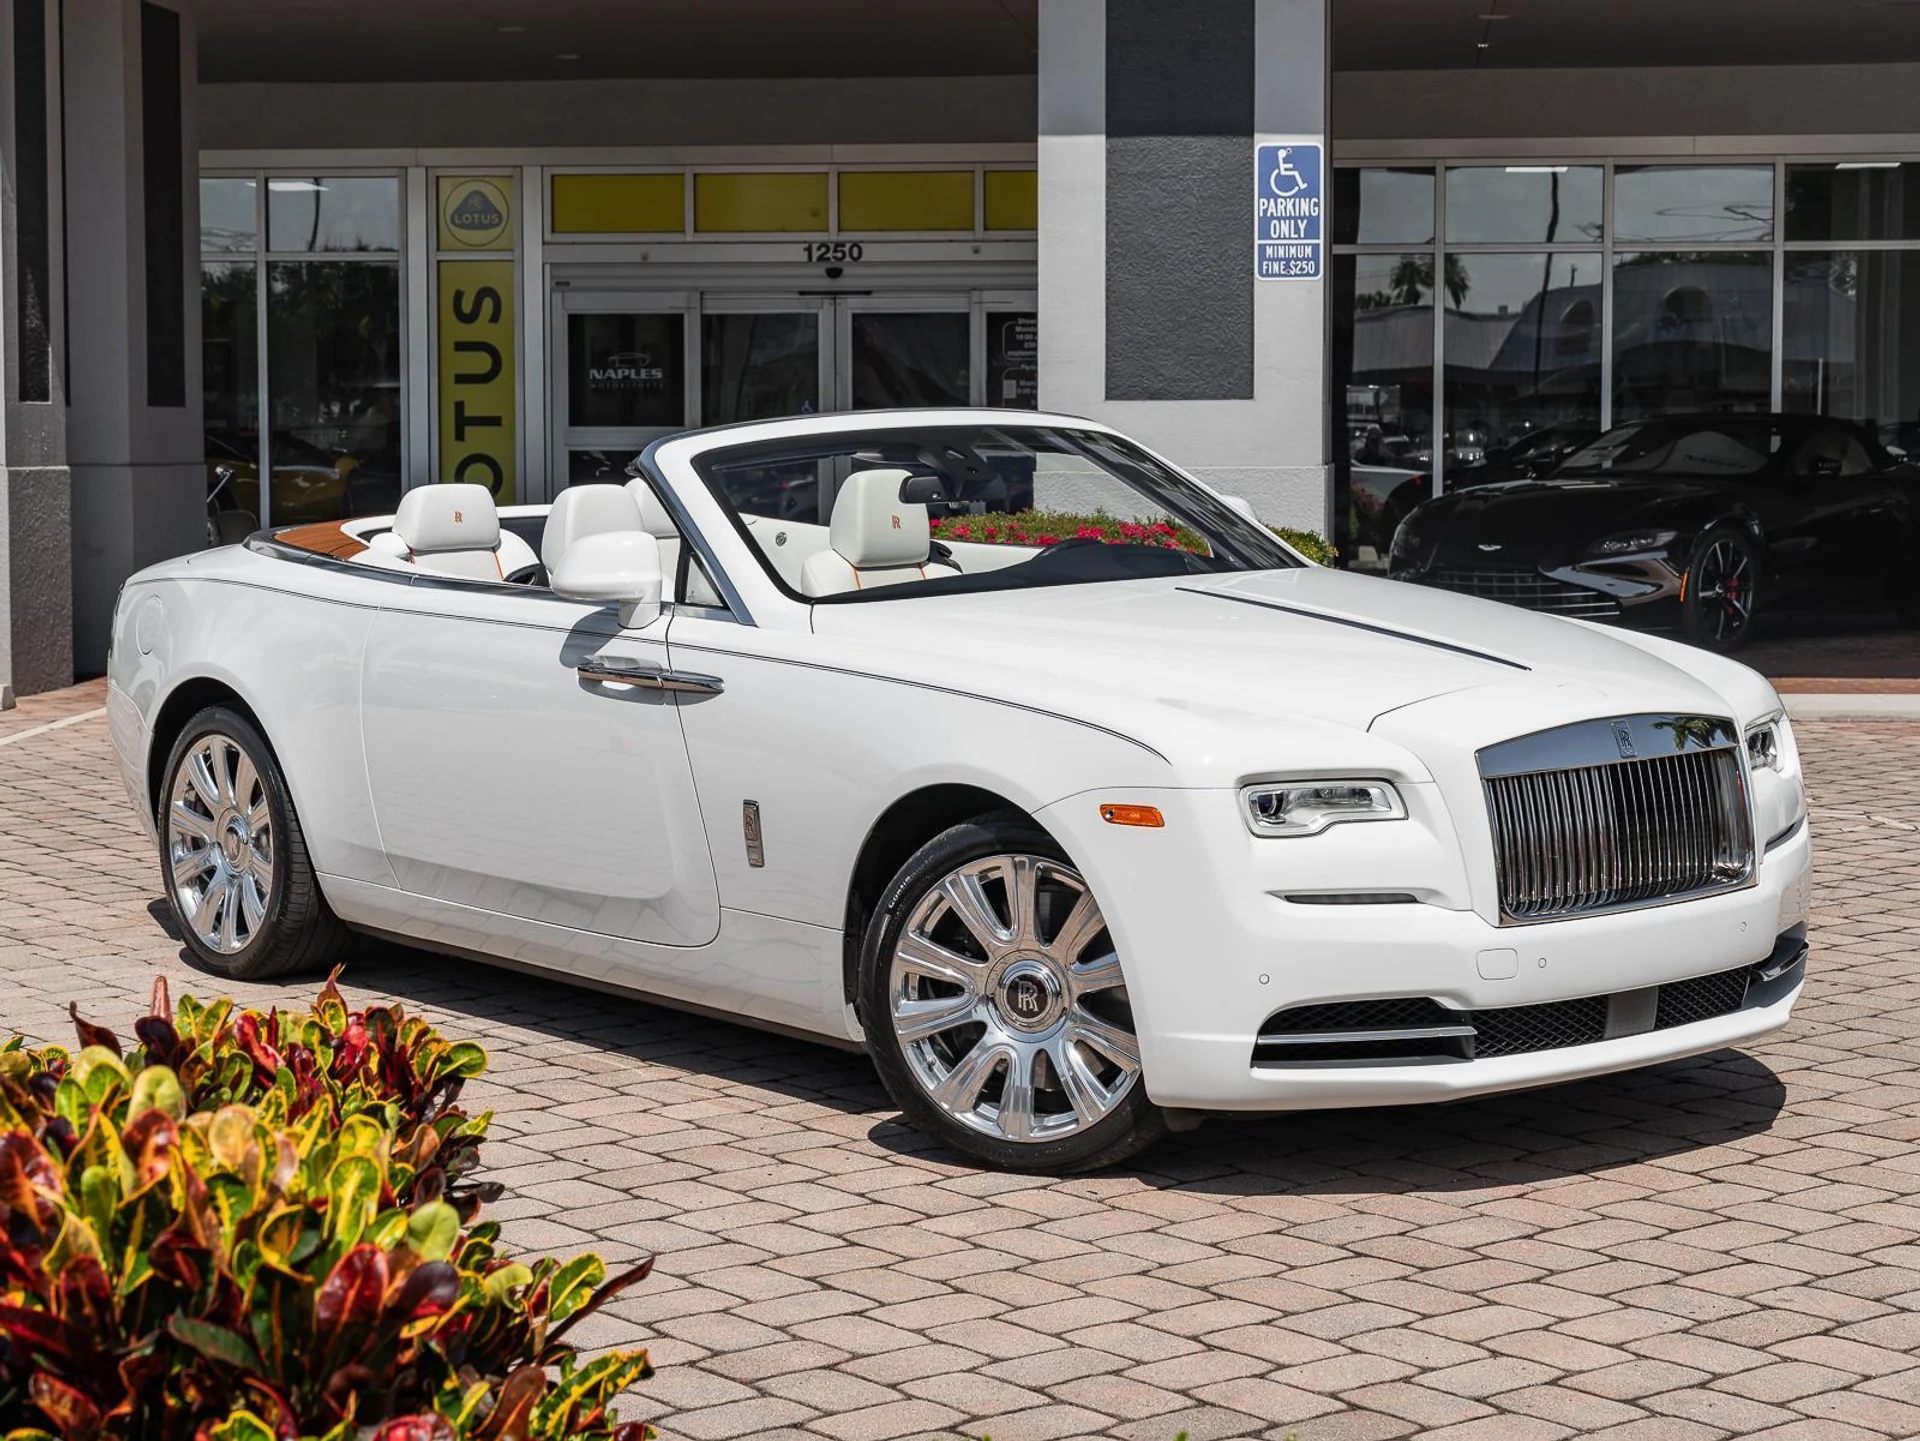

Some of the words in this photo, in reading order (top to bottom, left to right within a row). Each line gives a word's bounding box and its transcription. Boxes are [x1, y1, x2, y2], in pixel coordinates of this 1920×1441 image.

[1259, 198, 1319, 217] PARKING
[454, 213, 500, 225] LOTUS
[1270, 219, 1308, 239] ONLY
[803, 242, 863, 262] 1250
[1266, 244, 1312, 259] MINIMUM
[1262, 260, 1286, 274] FINE
[1290, 259, 1315, 275] $250
[589, 368, 663, 380] NAPLES
[452, 286, 503, 498] OTUS
